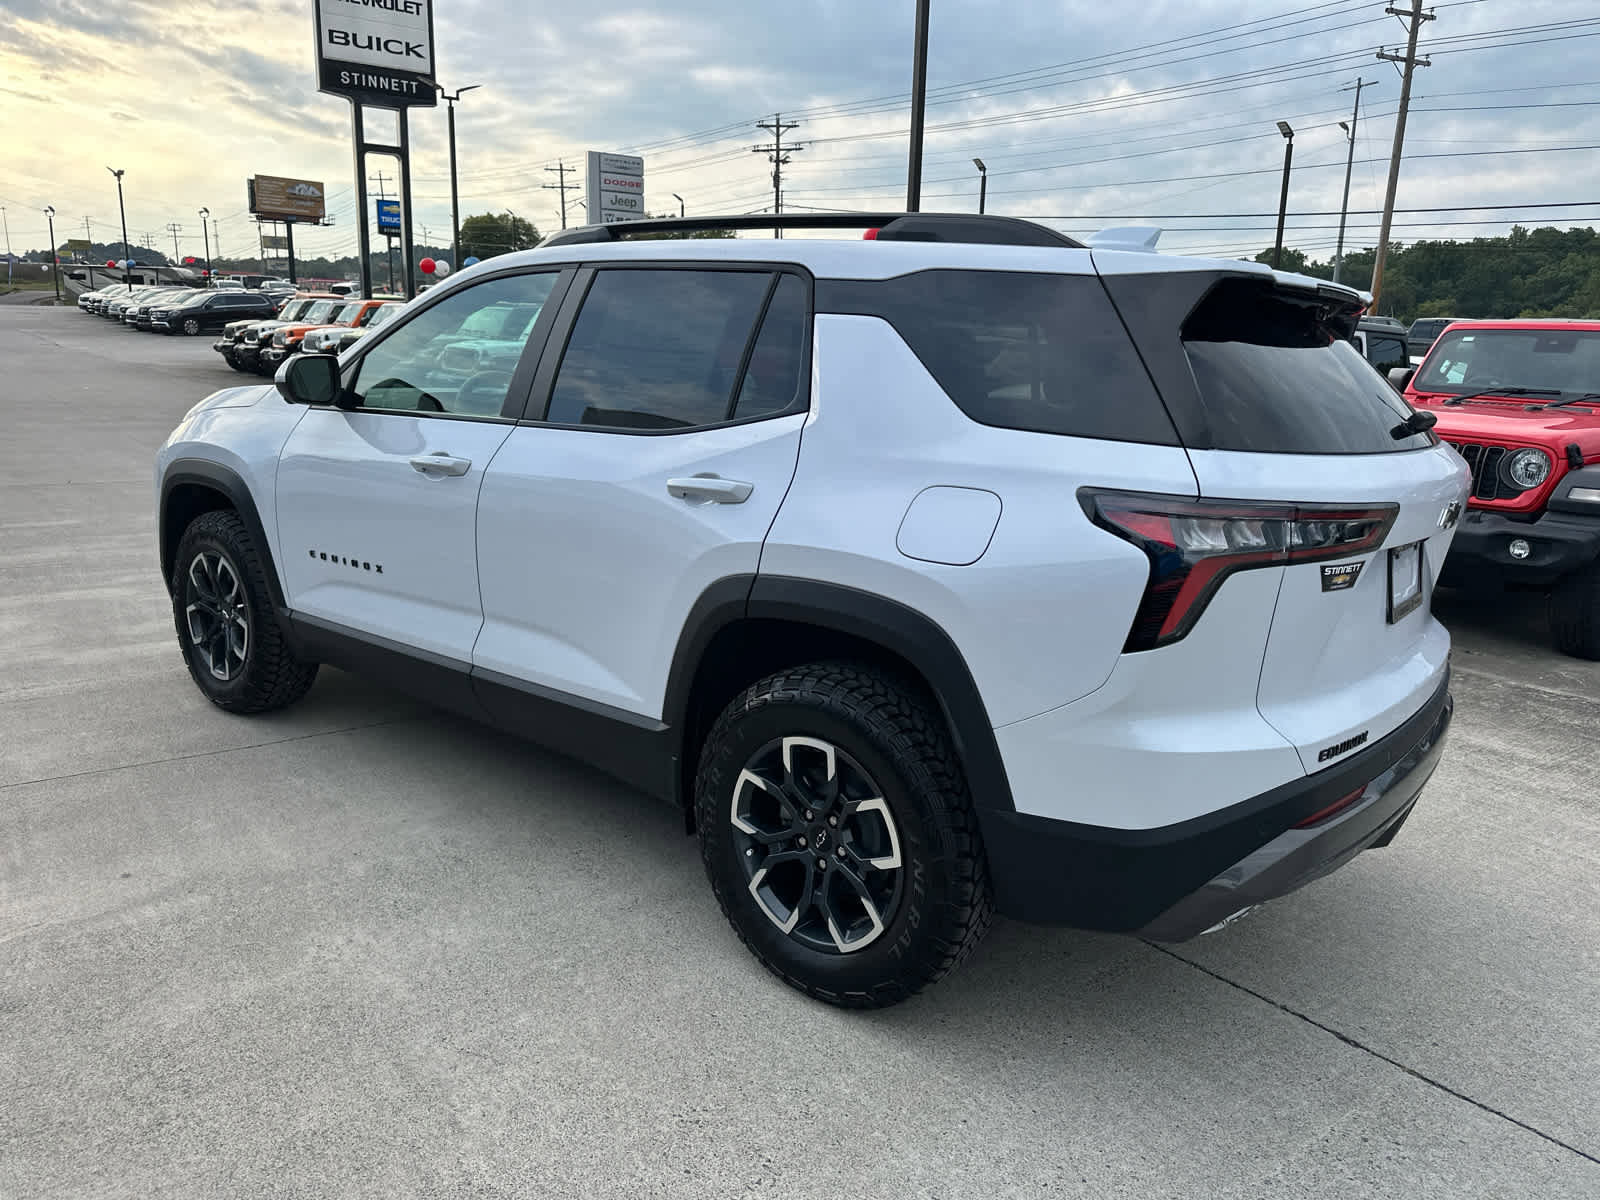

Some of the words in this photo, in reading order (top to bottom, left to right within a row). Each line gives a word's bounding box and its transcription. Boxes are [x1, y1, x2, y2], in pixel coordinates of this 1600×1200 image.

[338, 0, 423, 16] VROLET
[328, 29, 426, 59] BUICK
[340, 71, 418, 94] STINNETT
[604, 178, 641, 188] DODGE
[610, 195, 637, 208] Jeep
[308, 549, 383, 574] EQUINOX
[1324, 563, 1362, 575] STINNETT
[1318, 730, 1369, 762] EQUINOX
